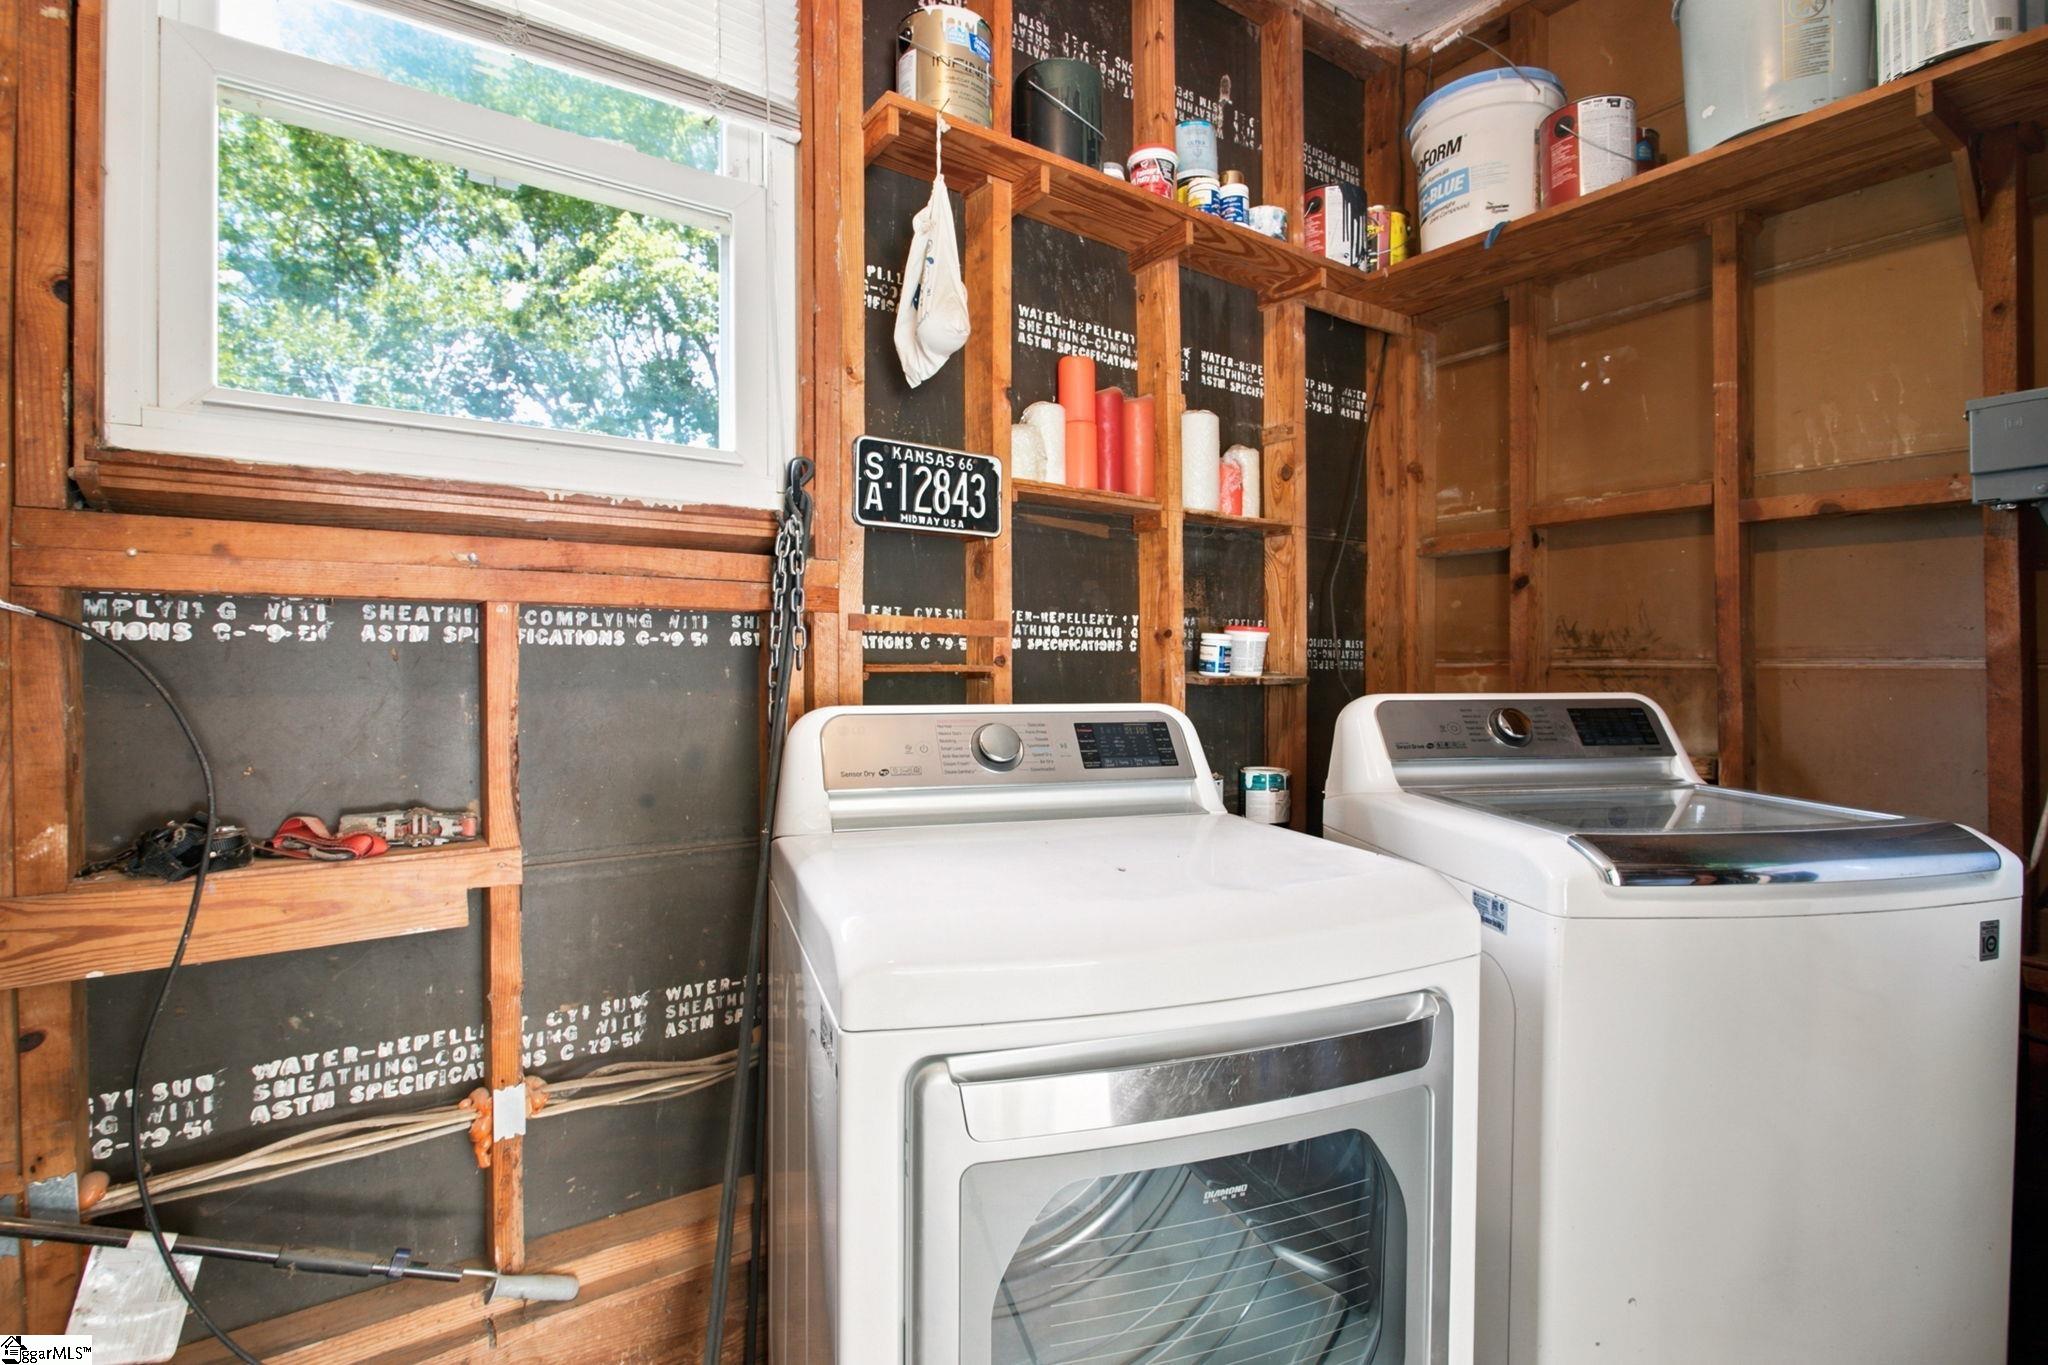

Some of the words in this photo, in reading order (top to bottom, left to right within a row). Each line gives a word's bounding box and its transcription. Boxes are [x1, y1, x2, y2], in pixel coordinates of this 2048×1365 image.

[891, 446, 954, 468] KANSAS
[958, 457, 974, 471] 66
[898, 462, 986, 519] 12843
[900, 513, 940, 526] MIDWAY
[943, 518, 965, 529] USA
[361, 624, 430, 643] ASTM
[840, 770, 862, 778] Sensor
[863, 769, 876, 778] Dry
[664, 1013, 715, 1039] ASTM
[251, 1091, 335, 1126] ASTM
[1203, 1183, 1248, 1200] DIAMOND
